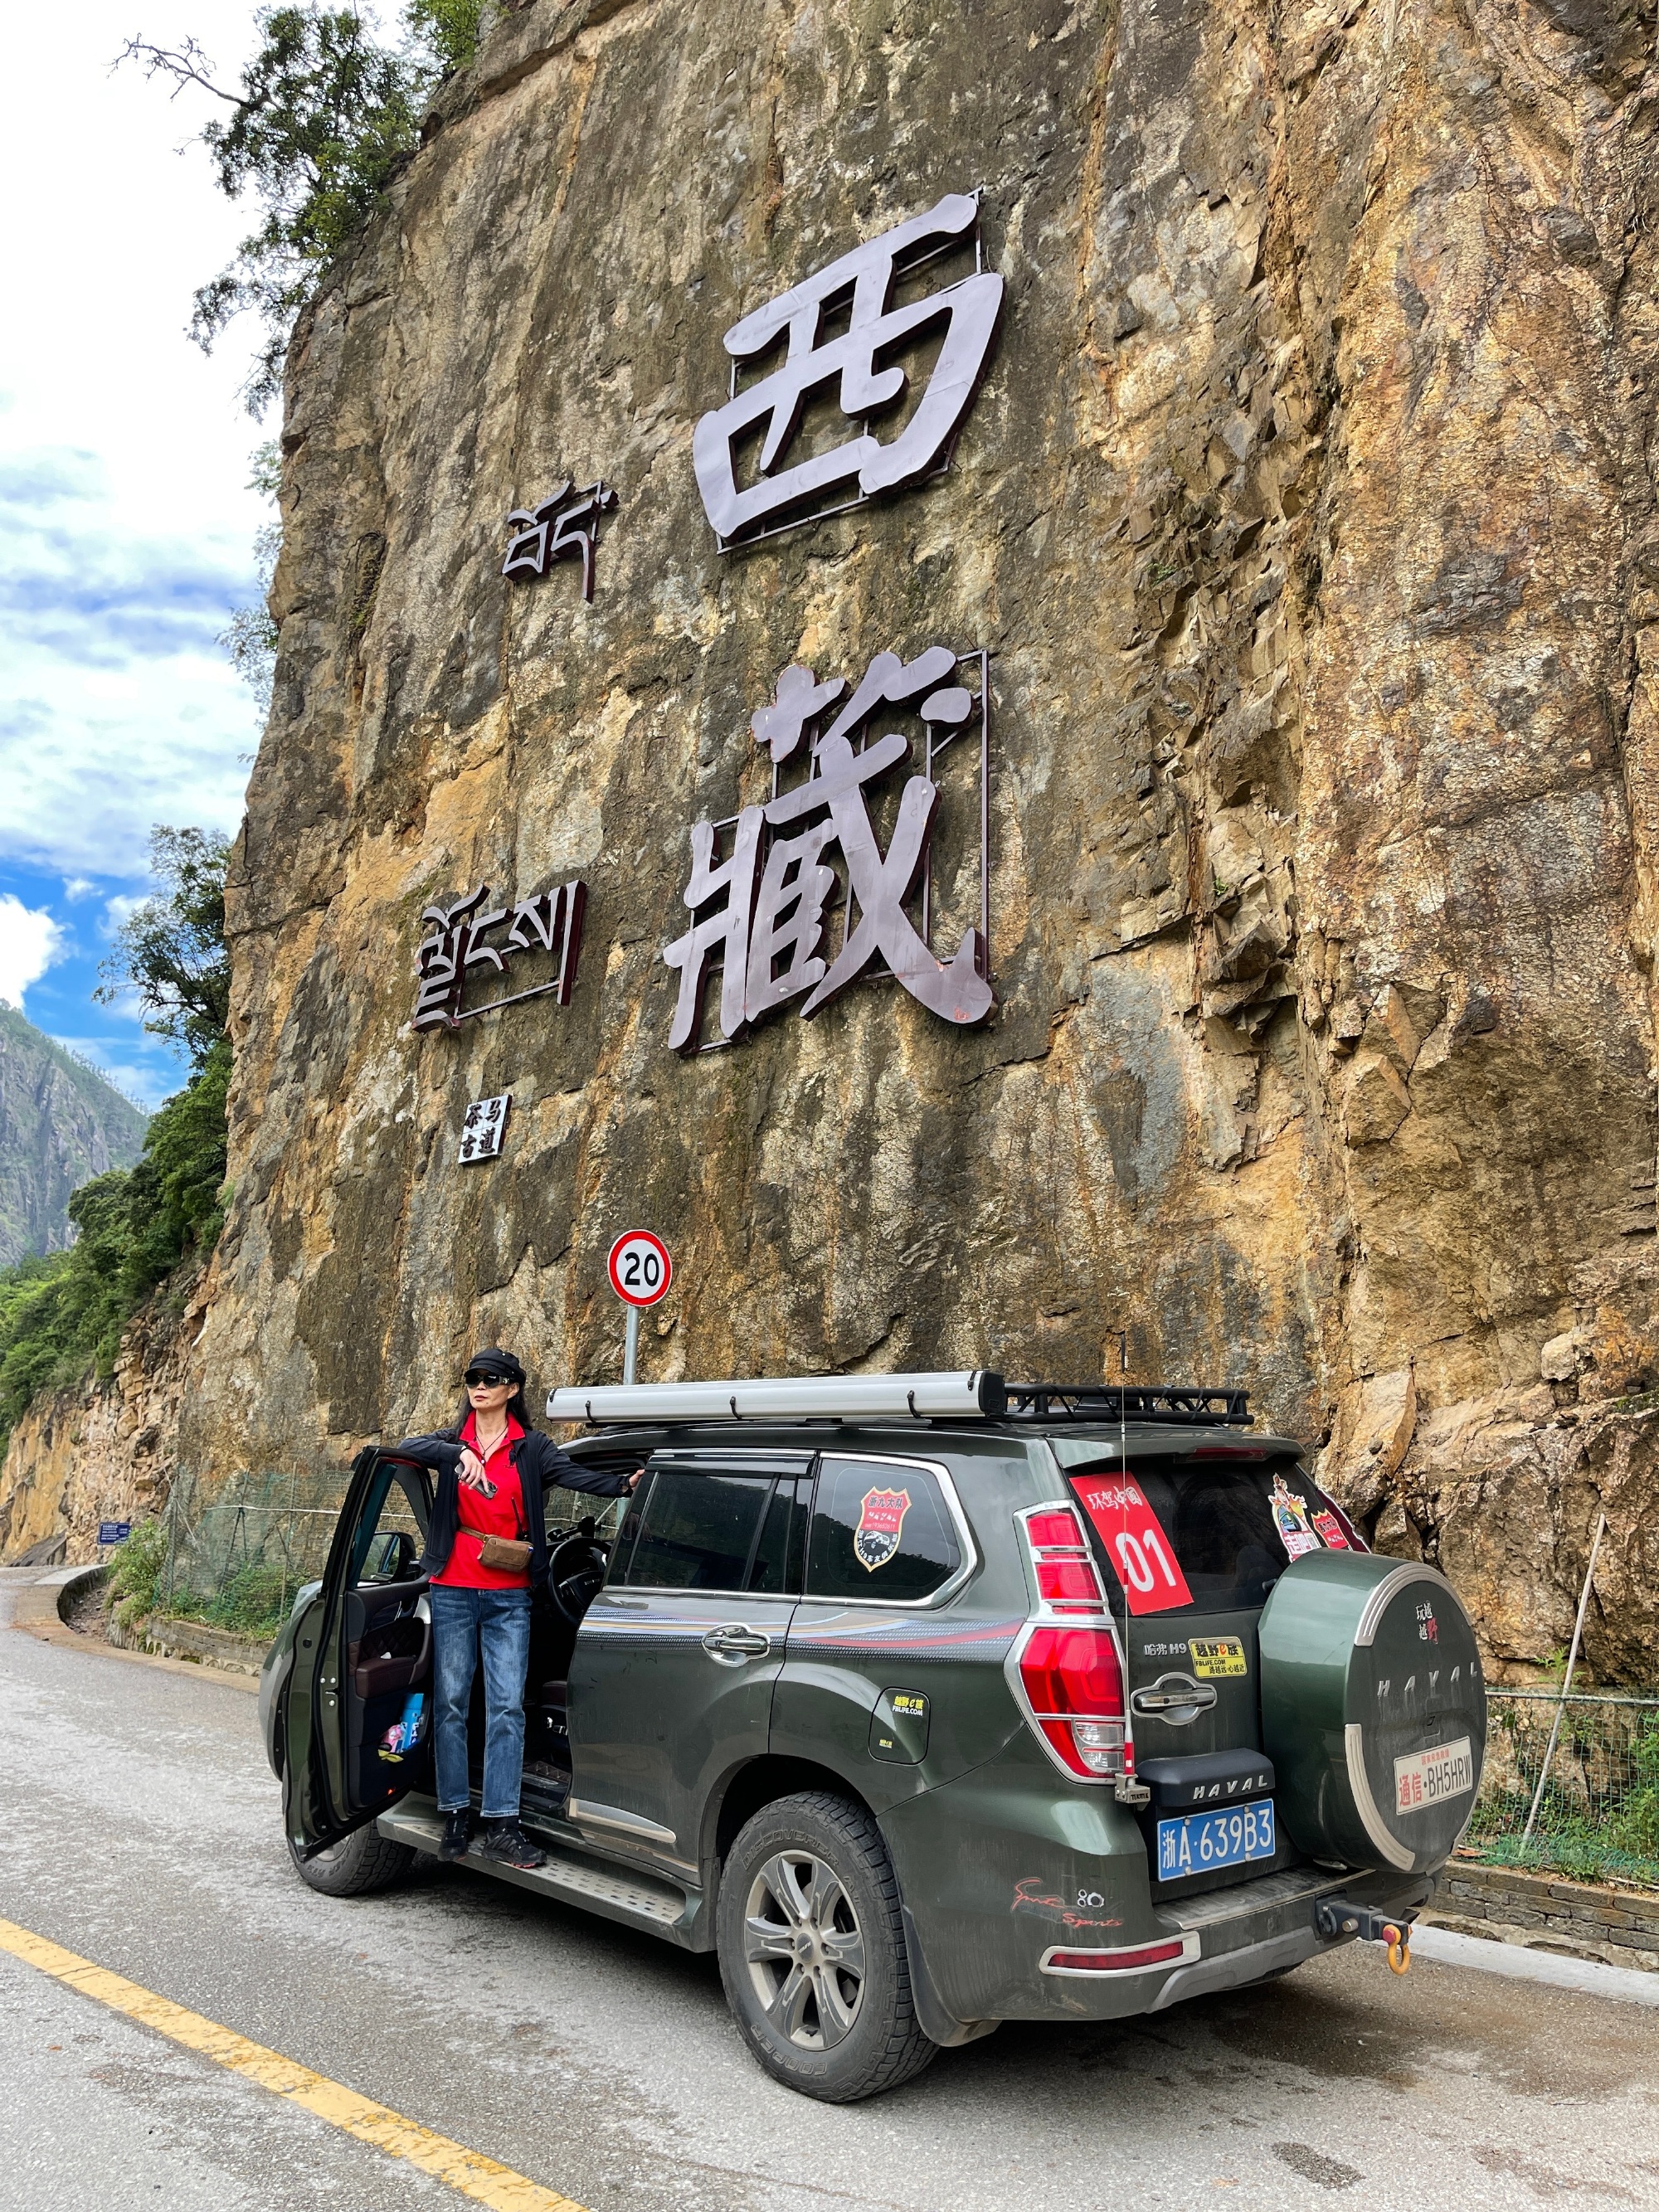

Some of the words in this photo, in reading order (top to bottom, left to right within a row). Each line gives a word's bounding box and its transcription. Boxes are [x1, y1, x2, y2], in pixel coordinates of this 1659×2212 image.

[625, 1252, 659, 1286] 20
[1115, 1529, 1177, 1592] 01
[1144, 1643, 1168, 1656] 哈弗
[1169, 1642, 1188, 1655] H9
[1195, 1659, 1226, 1667] FBLIFE.COM
[1377, 1661, 1478, 1698] HAVAL
[1193, 1774, 1268, 1801] HAVAL
